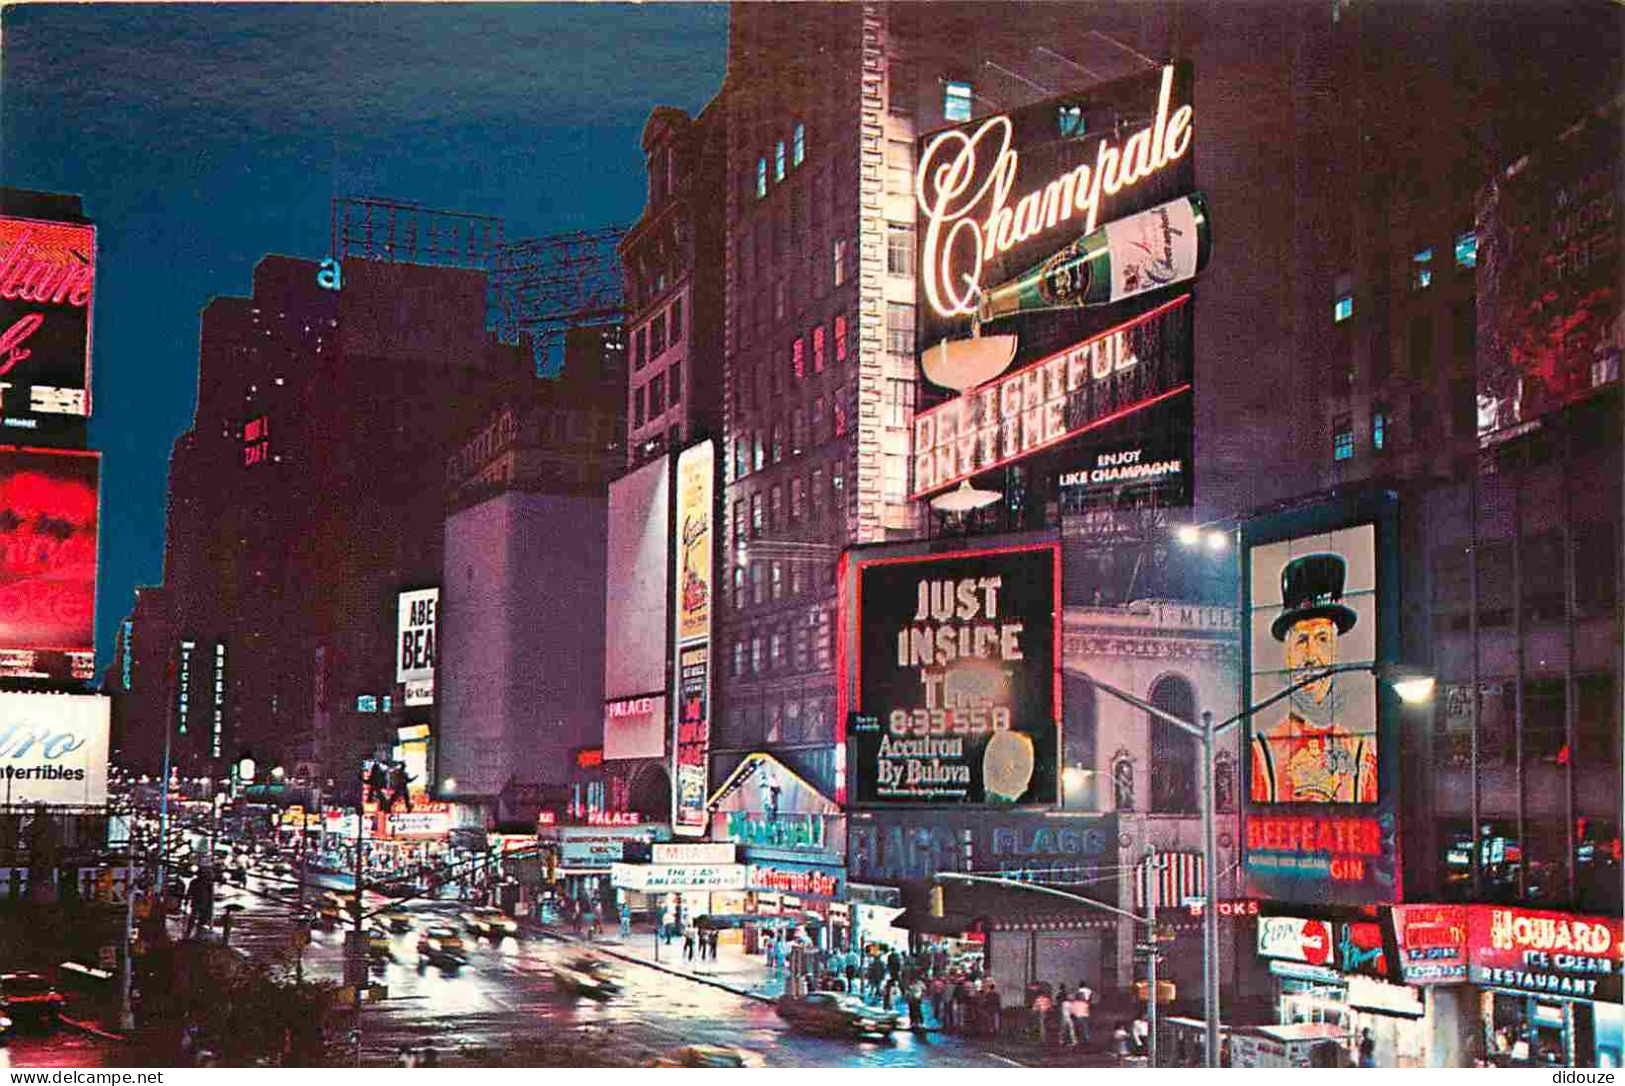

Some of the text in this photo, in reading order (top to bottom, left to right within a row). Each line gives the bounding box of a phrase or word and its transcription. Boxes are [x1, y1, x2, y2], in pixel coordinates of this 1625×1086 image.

[917, 64, 1194, 317] Champale
[1097, 449, 1142, 467] ENJOY
[1060, 459, 1183, 486] LIKE CHAMPAGNE
[409, 598, 435, 627] ABE
[914, 575, 1003, 622] JUST
[897, 623, 1024, 667] INSIDE
[180, 651, 190, 734] VICTORIA
[608, 698, 654, 718] PALACE
[877, 733, 963, 758] Accutron
[0, 763, 86, 782] vertibles
[878, 758, 972, 787] By Bulova
[587, 812, 640, 825] PALACE
[1247, 815, 1382, 854] BEEFEATER
[1329, 857, 1366, 881] GIN
[1190, 902, 1260, 917] BOKS
[1490, 909, 1612, 954] HOWARD
[1553, 952, 1613, 974] CREAM
[1480, 966, 1598, 995] RESTAURANT
